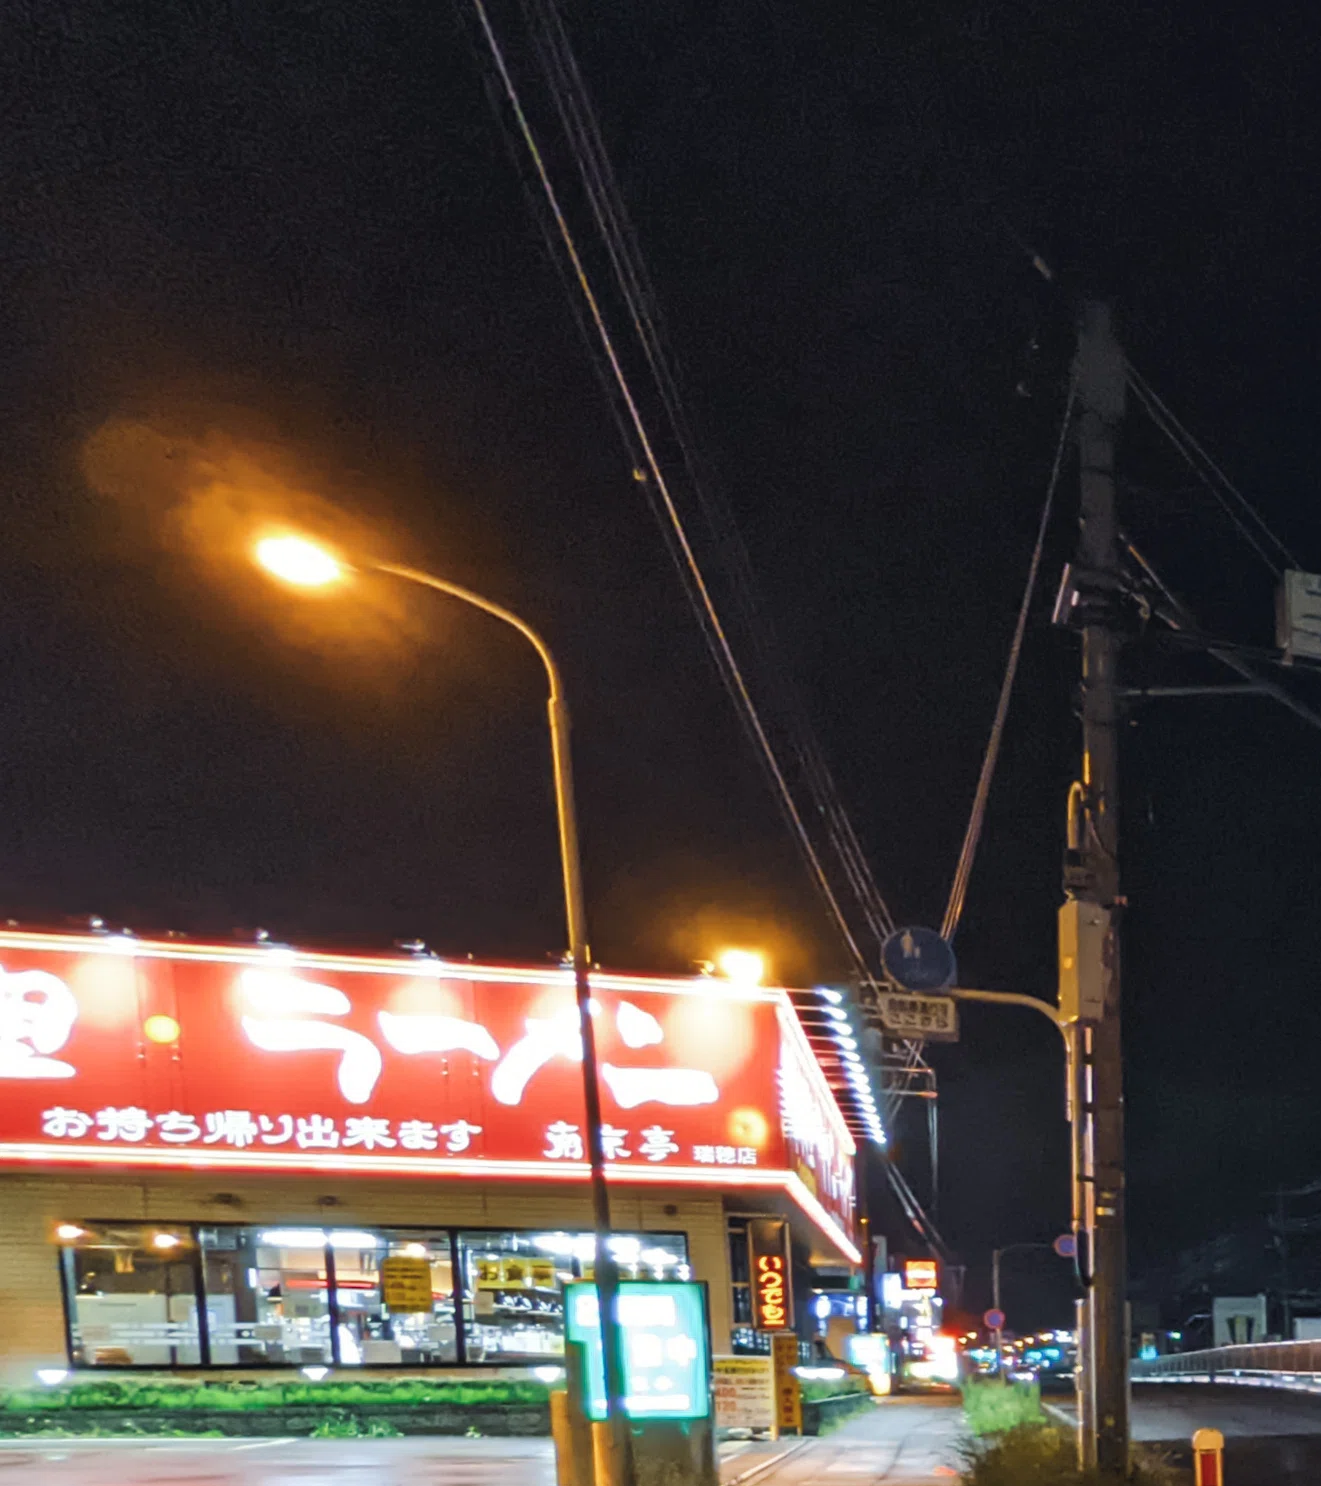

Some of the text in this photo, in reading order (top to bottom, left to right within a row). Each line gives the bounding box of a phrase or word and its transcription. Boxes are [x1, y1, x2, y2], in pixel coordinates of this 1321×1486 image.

[42, 1106, 482, 1152] お持ち帰り出来ます
[692, 1145, 757, 1166] 瑞穂店
